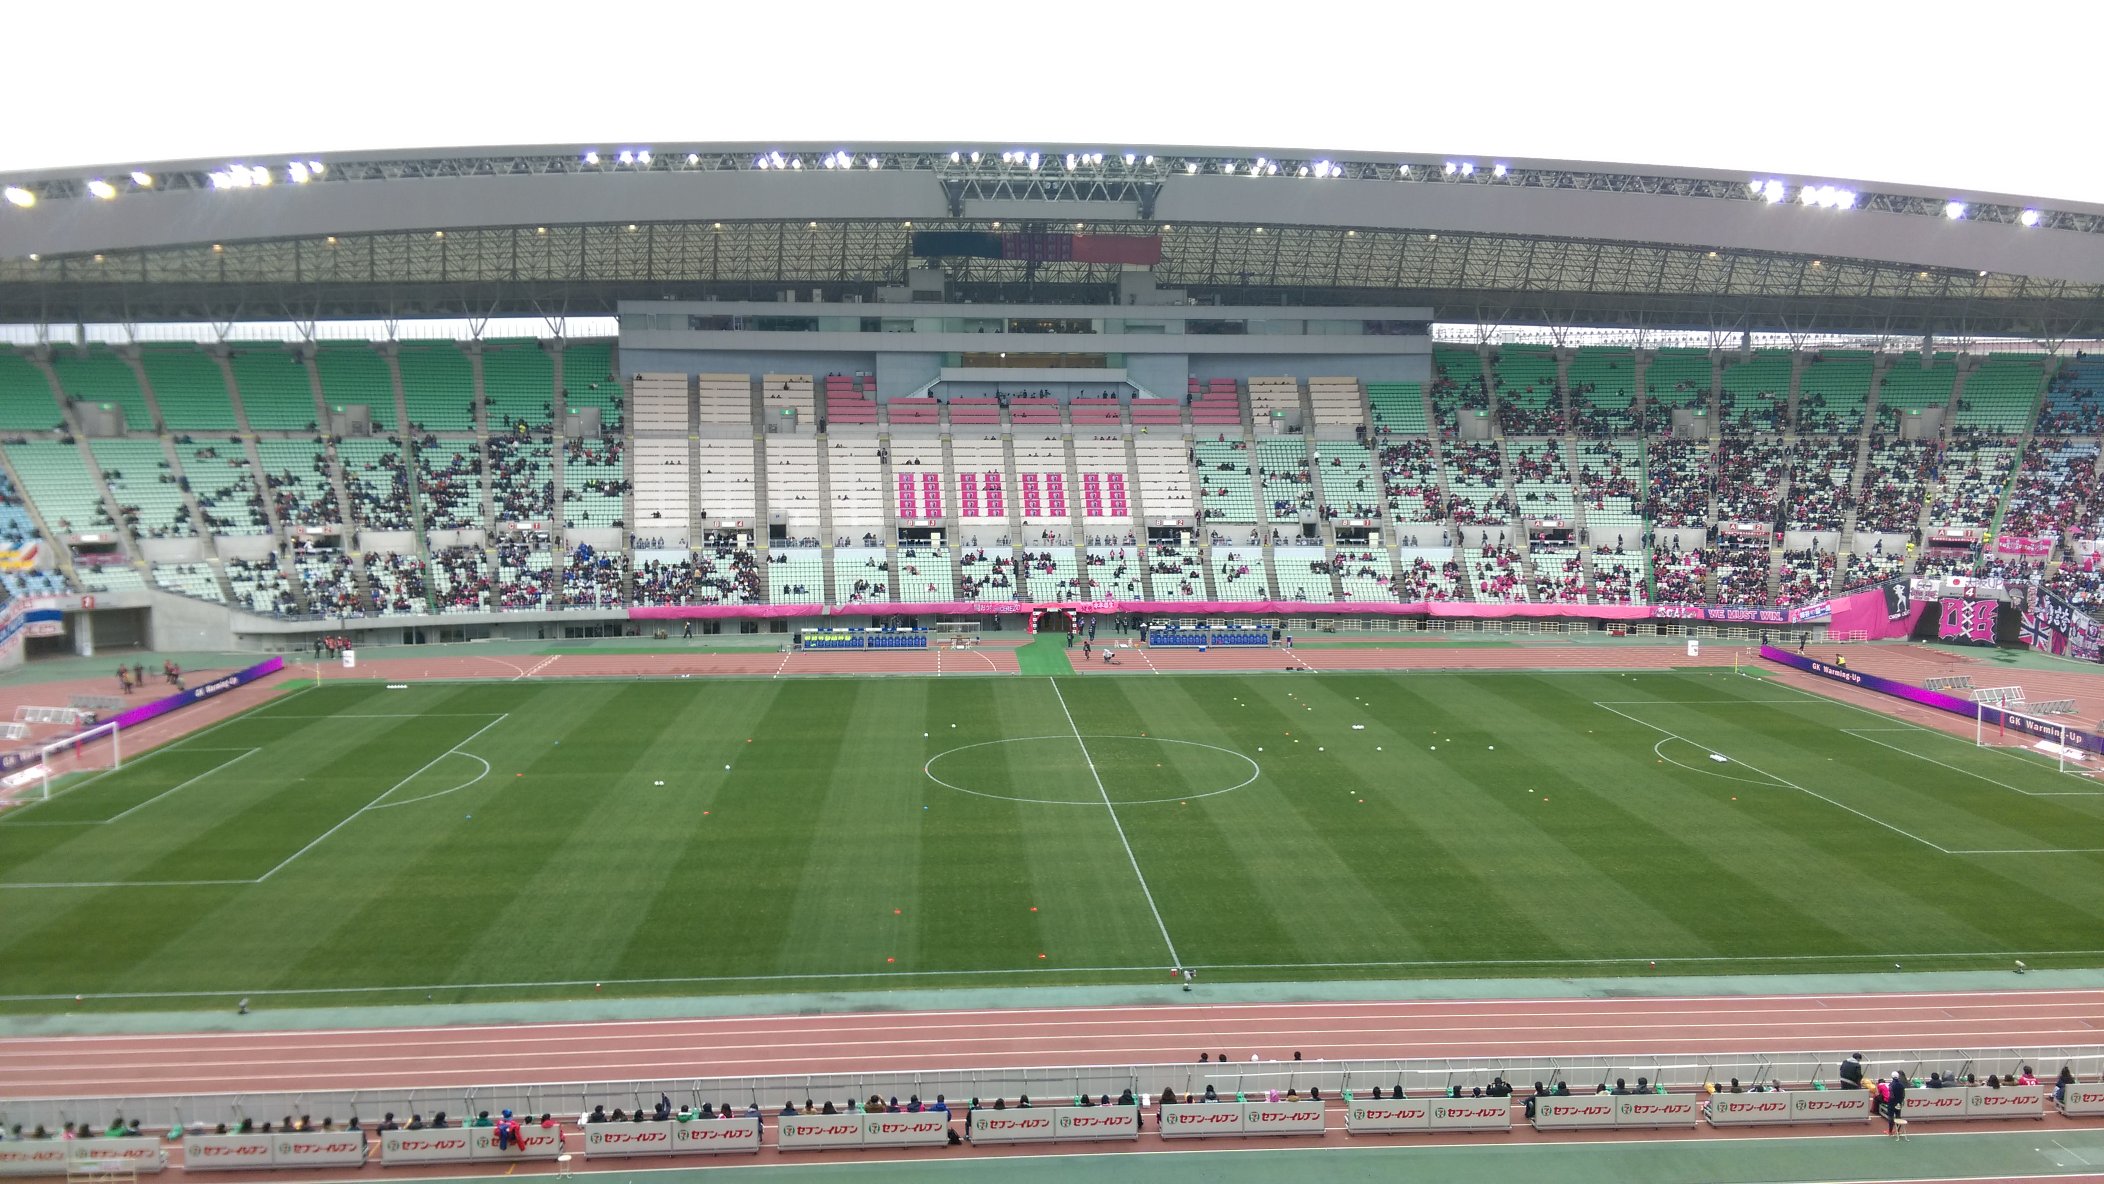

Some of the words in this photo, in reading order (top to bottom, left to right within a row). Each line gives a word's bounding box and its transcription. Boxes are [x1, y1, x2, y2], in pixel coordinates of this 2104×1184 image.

[1966, 588, 1974, 596] 4
[1708, 609, 1725, 618] WE
[1728, 610, 1757, 620] MUST
[1760, 611, 1783, 622] WIN.
[1812, 662, 1820, 671] GK
[1824, 666, 1861, 682] Warming-Up
[2009, 716, 2020, 726] GK
[2026, 720, 2082, 743] Warmin-Up
